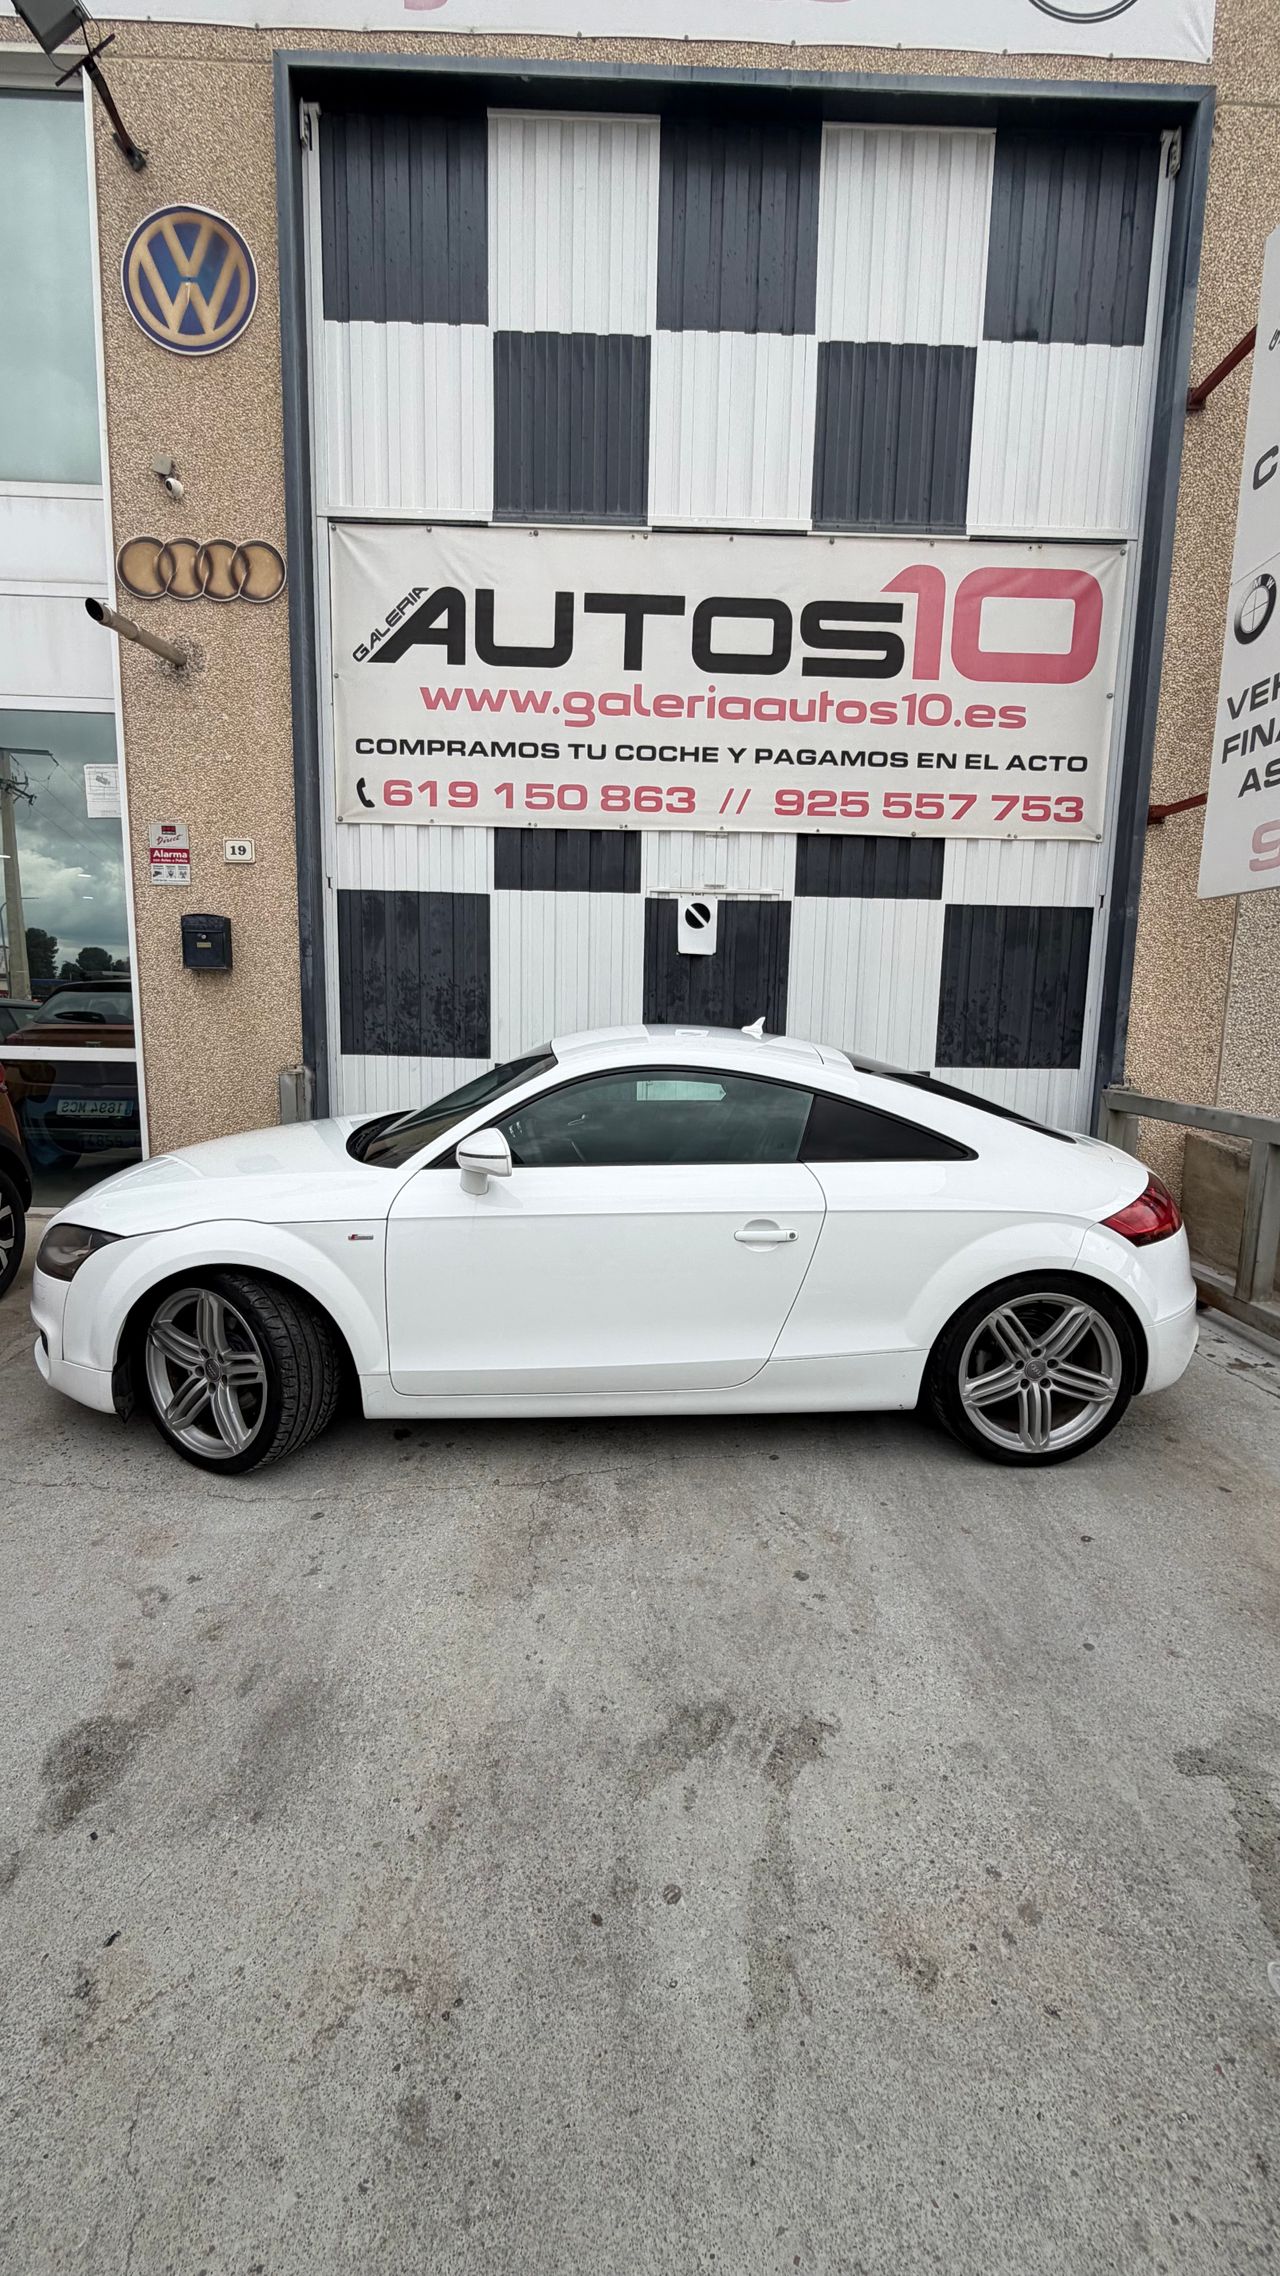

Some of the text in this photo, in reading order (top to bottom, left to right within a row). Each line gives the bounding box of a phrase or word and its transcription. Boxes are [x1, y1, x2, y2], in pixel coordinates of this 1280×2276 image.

[352, 587, 429, 663] GALERIA
[420, 685, 1027, 728] www.galeriaautos10.es
[355, 738, 1088, 773] COMPRAMOS TU COCHE Y PAGAMOS EN EL ACTO
[383, 779, 478, 809] 619
[495, 783, 588, 811] 150
[600, 785, 696, 814] 863
[774, 789, 870, 818] 925
[882, 792, 977, 820] 557
[991, 794, 1084, 823] 753
[153, 850, 188, 859] Alarma
[230, 845, 247, 856] 19
